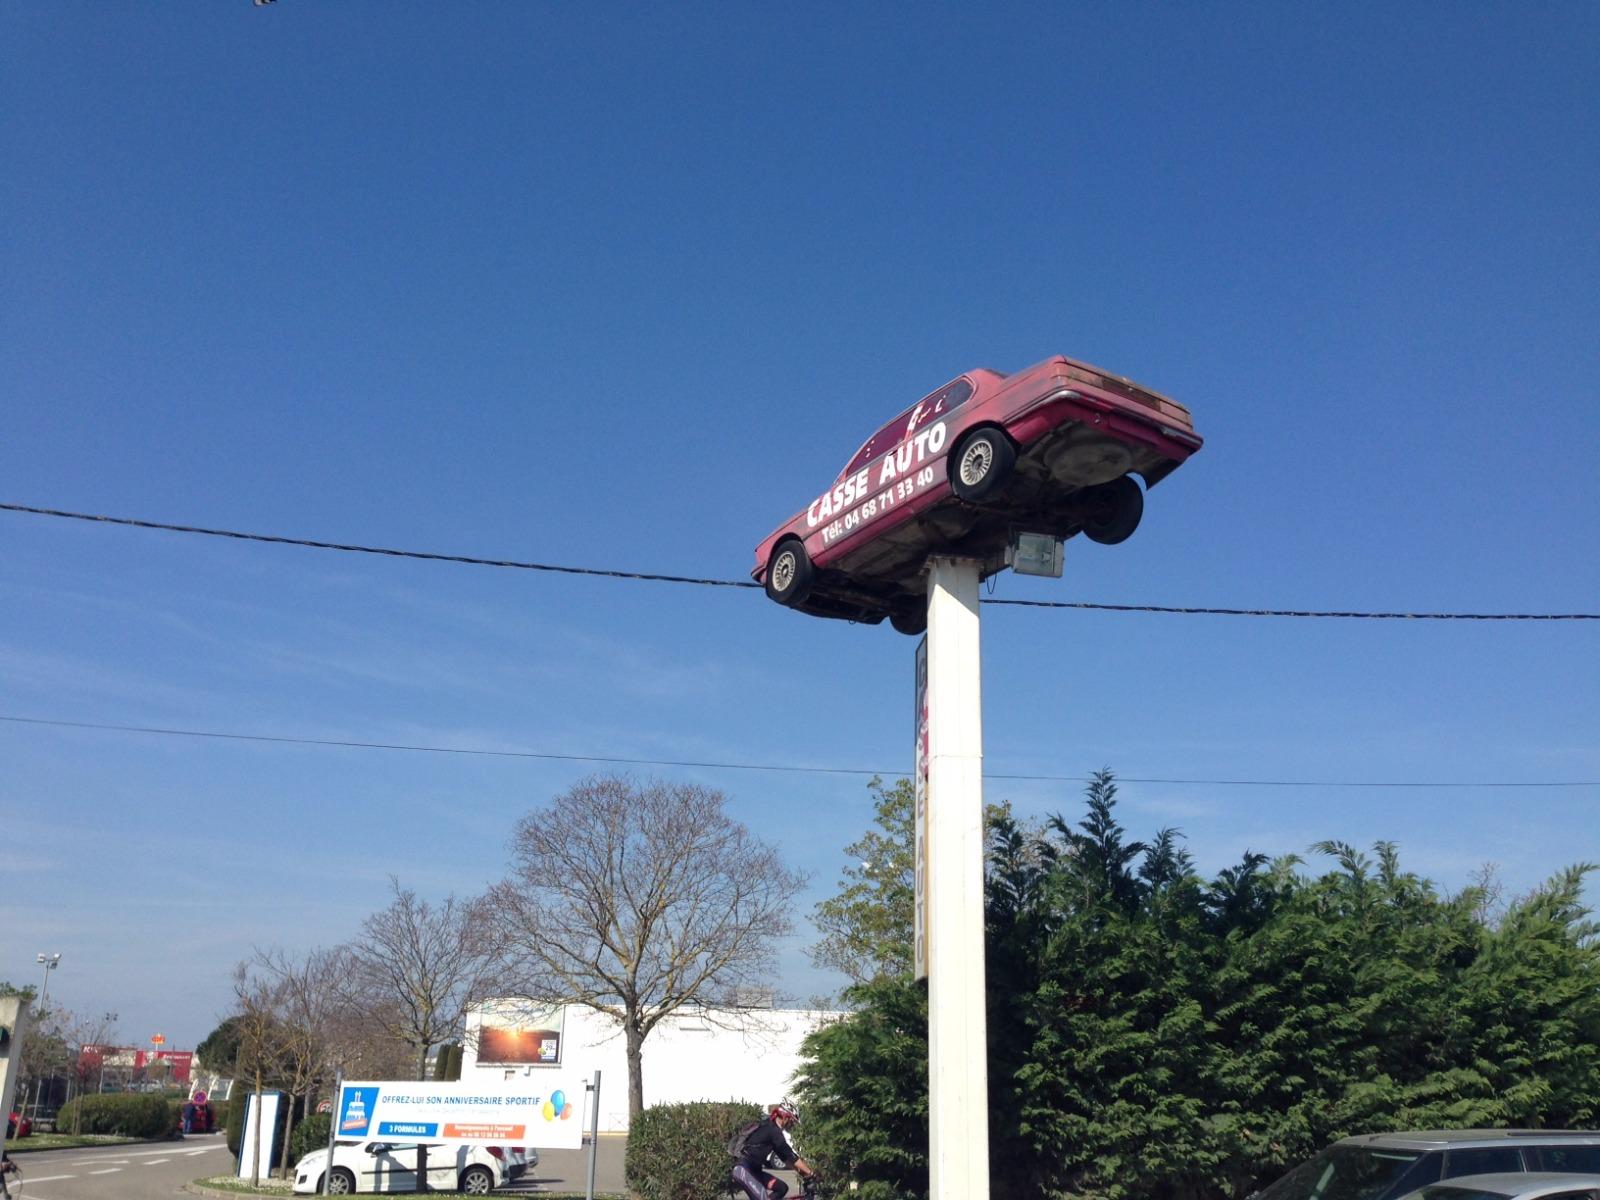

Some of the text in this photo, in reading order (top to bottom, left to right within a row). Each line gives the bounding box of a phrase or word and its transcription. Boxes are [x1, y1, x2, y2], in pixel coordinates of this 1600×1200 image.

[807, 421, 946, 527] CASSE AUTO
[844, 509, 859, 530] 04
[861, 499, 877, 519] 68
[878, 490, 894, 509] 71
[897, 477, 913, 499] 33
[917, 466, 933, 487] 40
[382, 1095, 541, 1106] OFFREZ-LUI SON ANNIVERSAIRE SPORTIF
[394, 1125, 427, 1134] FORMULES
